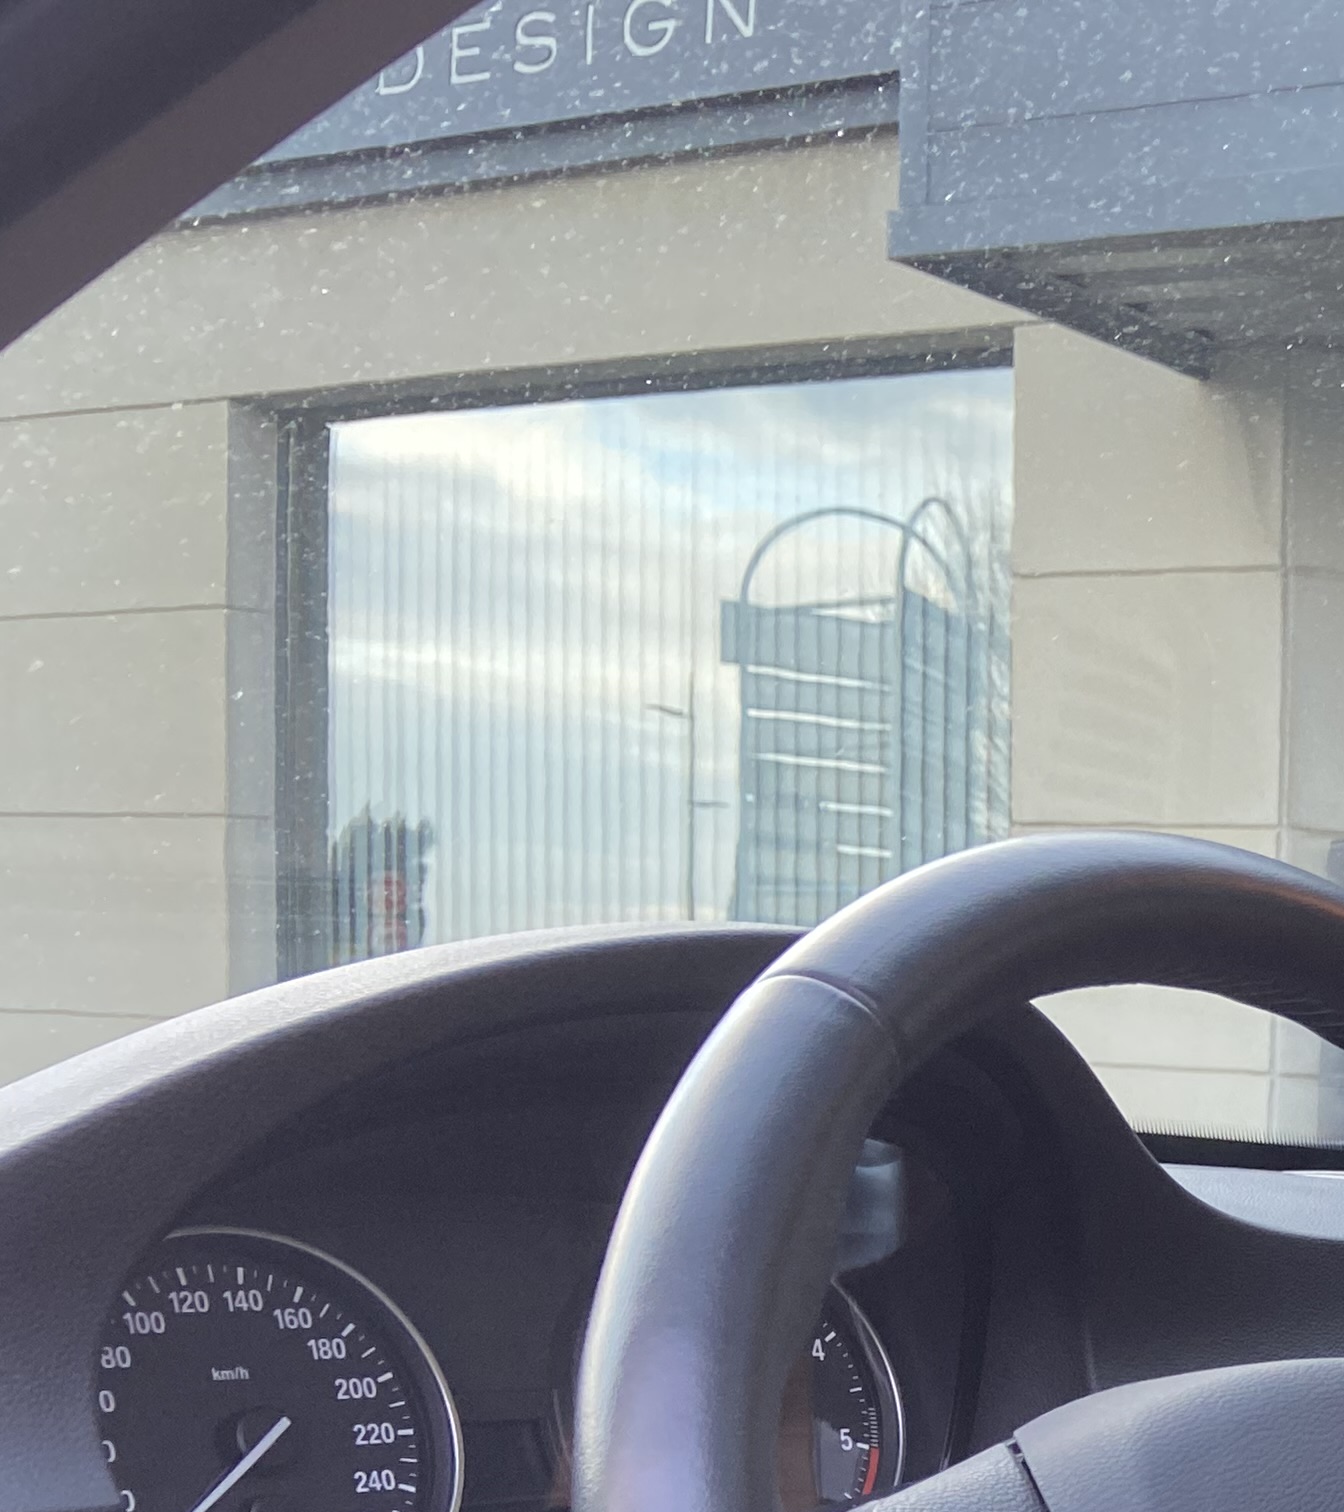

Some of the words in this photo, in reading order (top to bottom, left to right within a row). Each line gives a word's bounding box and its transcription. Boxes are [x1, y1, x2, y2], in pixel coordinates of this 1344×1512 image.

[168, 1290, 210, 1313] 120
[222, 1289, 264, 1313] 140
[122, 1311, 166, 1334] 100
[273, 1307, 313, 1330] 160
[307, 1338, 346, 1360] 180
[811, 1338, 826, 1361] 4
[211, 1366, 250, 1381] km/h
[335, 1377, 377, 1400] 200
[353, 1422, 396, 1446] 220
[839, 1428, 853, 1451] 5
[353, 1469, 396, 1493] 240
